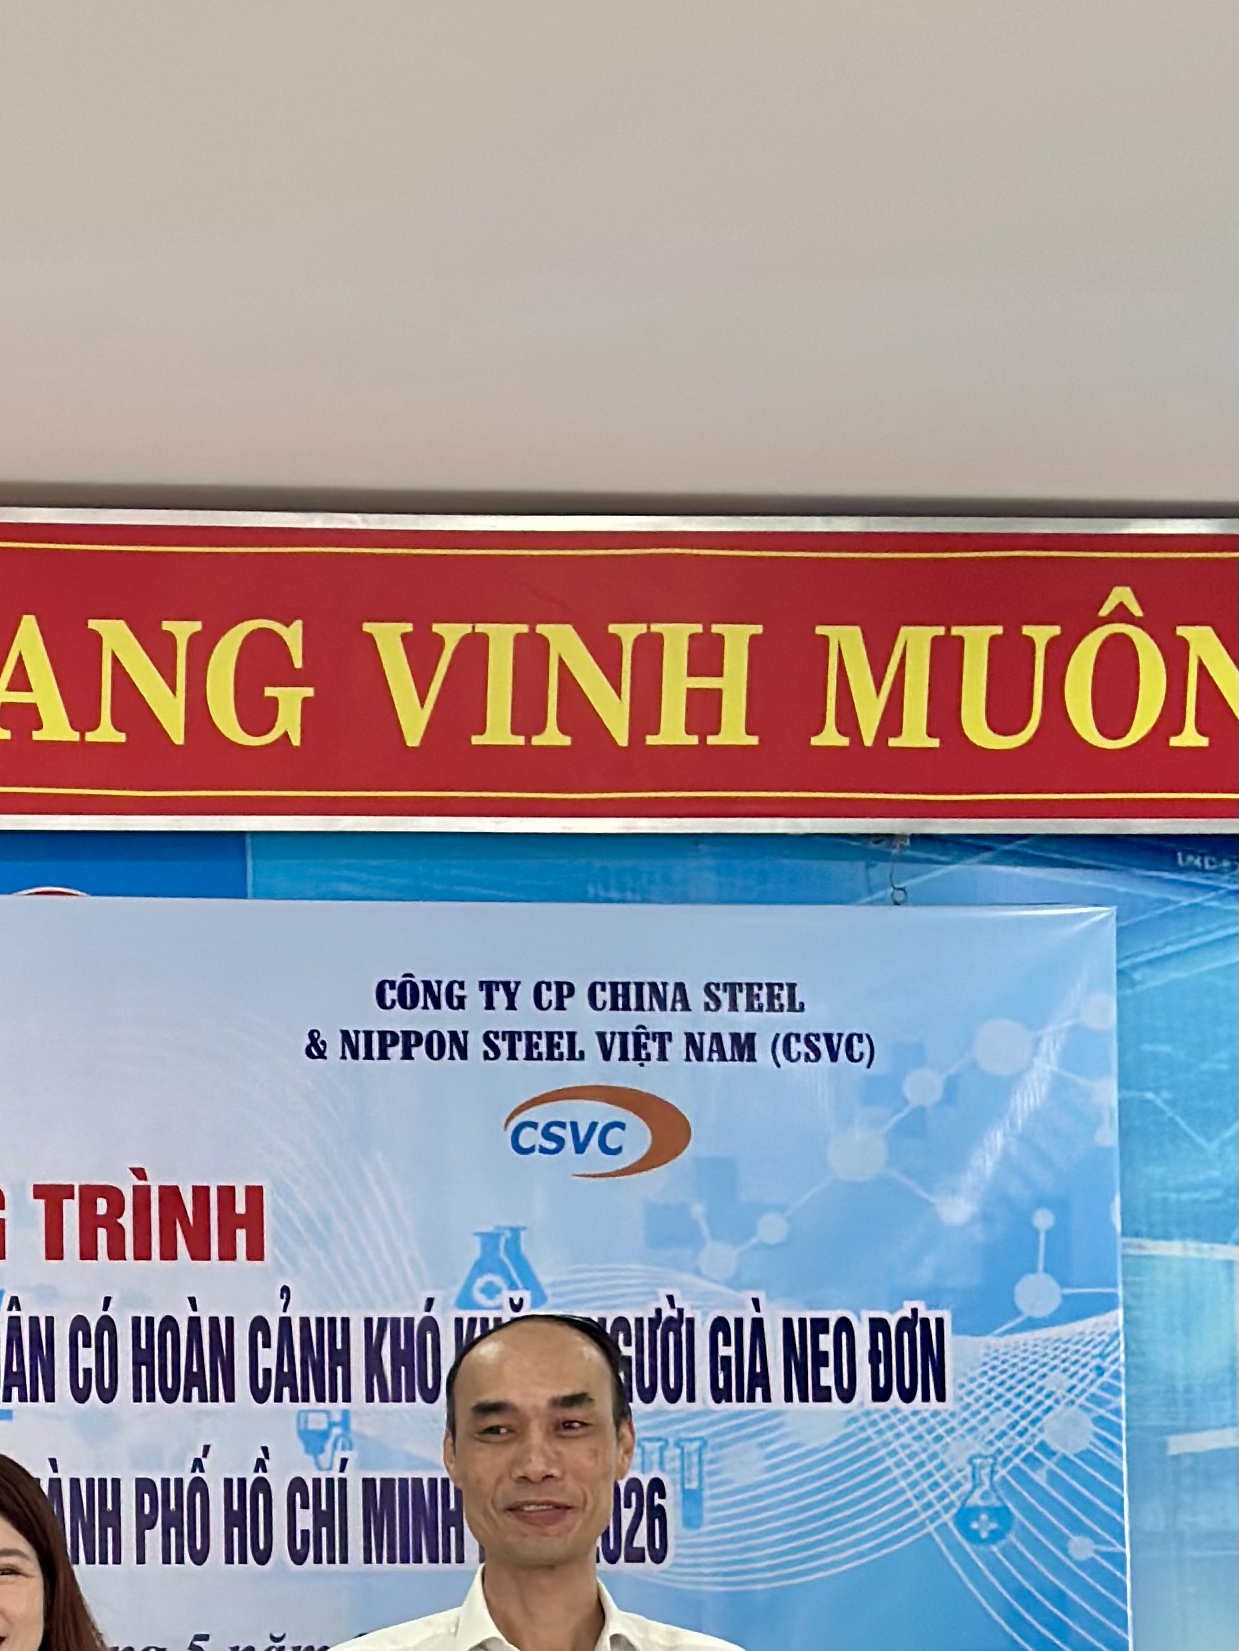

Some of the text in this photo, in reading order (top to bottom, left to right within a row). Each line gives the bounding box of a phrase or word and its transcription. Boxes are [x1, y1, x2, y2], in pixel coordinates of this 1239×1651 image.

[362, 622, 763, 748] VINH
[376, 973, 805, 1013] CÔNG TY CP CHINA STEEL
[305, 1024, 876, 1069] & NIPPON STEEL VIỆT NAM (CSVC)
[510, 1120, 626, 1155] CSVC
[33, 1167, 265, 1262] TRÌNH
[68, 1296, 118, 1404] CÓ
[132, 1296, 234, 1404] HOÀN
[248, 1285, 350, 1404] CẢNH
[364, 1297, 442, 1404] KHÓ
[598, 1294, 695, 1404] GƯỜI
[708, 1299, 770, 1404] GIÀ
[783, 1316, 855, 1404] NEO
[868, 1306, 947, 1404] ĐƠN
[135, 1446, 208, 1566] PHỐ
[223, 1446, 273, 1566] HỒ
[286, 1458, 349, 1565] CHÍ
[362, 1477, 465, 1564] MINH
[598, 1477, 668, 1564] 026
